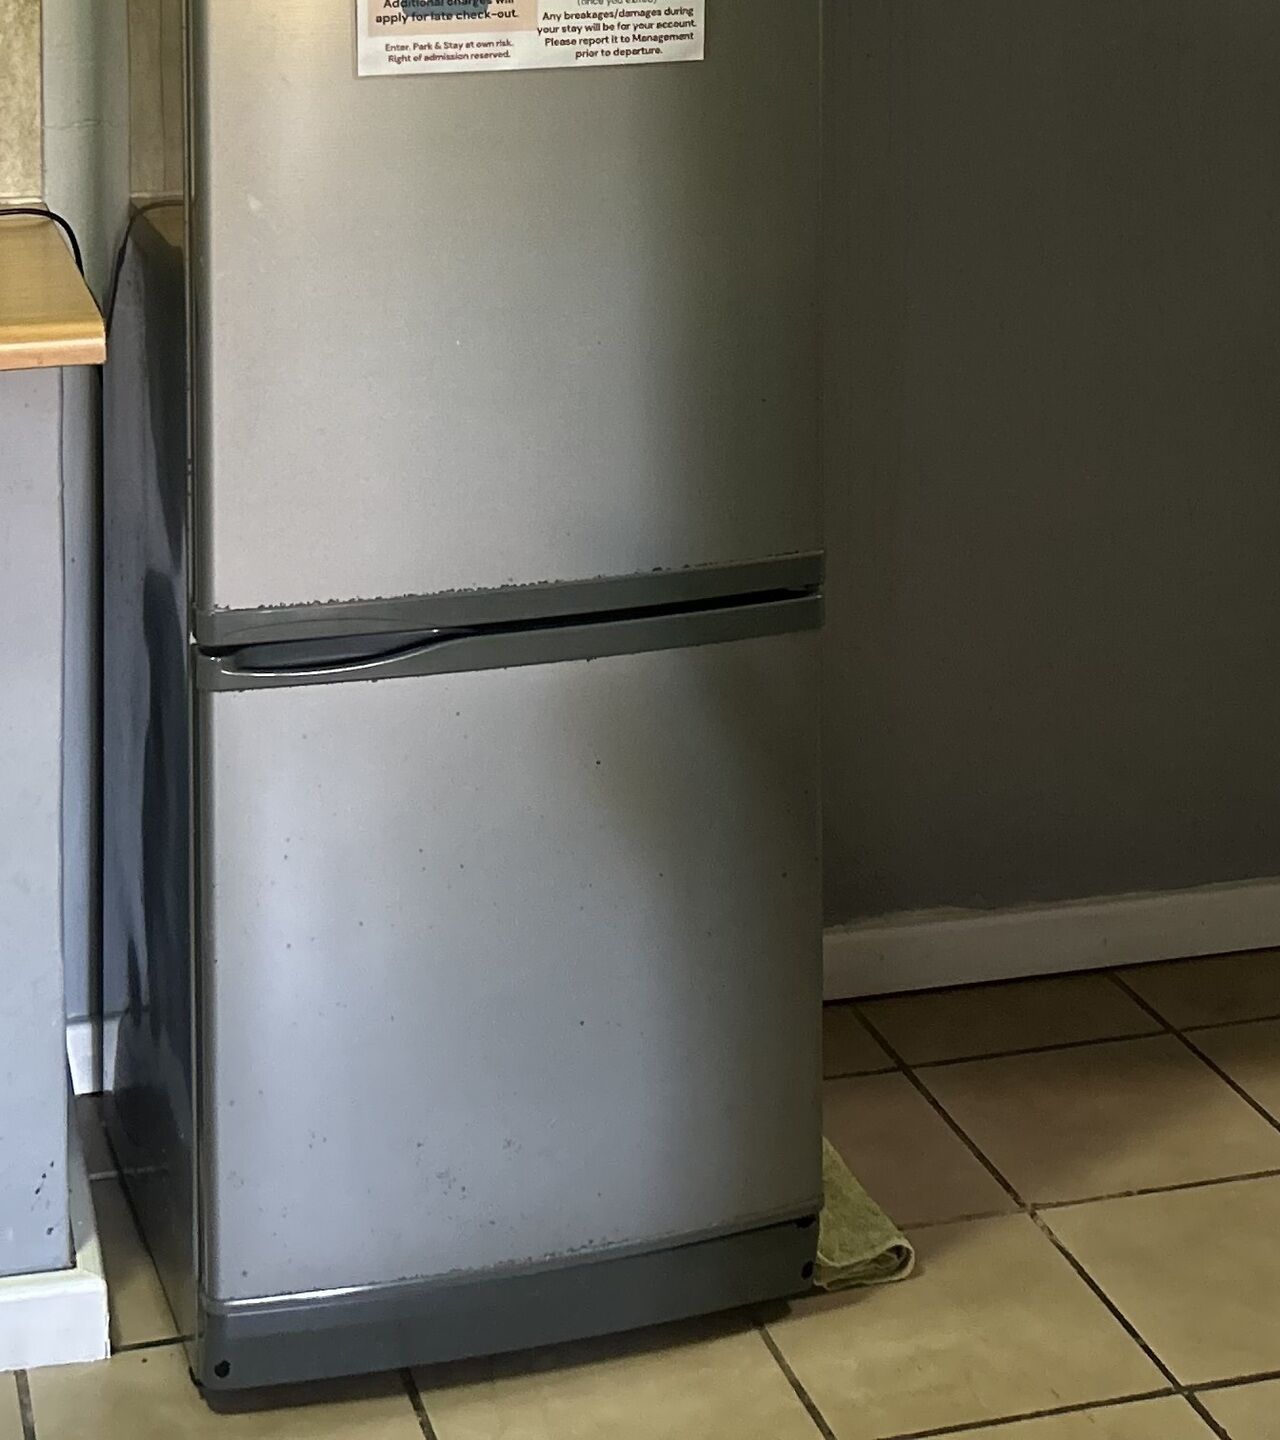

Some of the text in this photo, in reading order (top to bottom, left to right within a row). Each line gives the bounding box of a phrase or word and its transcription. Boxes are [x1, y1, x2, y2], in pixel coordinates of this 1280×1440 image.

[375, 8, 519, 25] apply for late check-out.
[542, 6, 694, 22] Any breakages/damages during
[537, 24, 560, 36] your
[561, 23, 582, 35] stay
[585, 22, 601, 32] will
[603, 22, 615, 31] be
[617, 21, 631, 30] for
[633, 21, 654, 31] your
[413, 42, 433, 51] Park
[434, 41, 441, 50] &
[443, 41, 464, 51] Stay
[465, 41, 475, 49] at
[545, 31, 694, 47] Please report it to Management
[388, 53, 411, 64] Right
[413, 52, 422, 61] of
[424, 51, 469, 61] admission
[575, 45, 663, 59] prior to departure.
